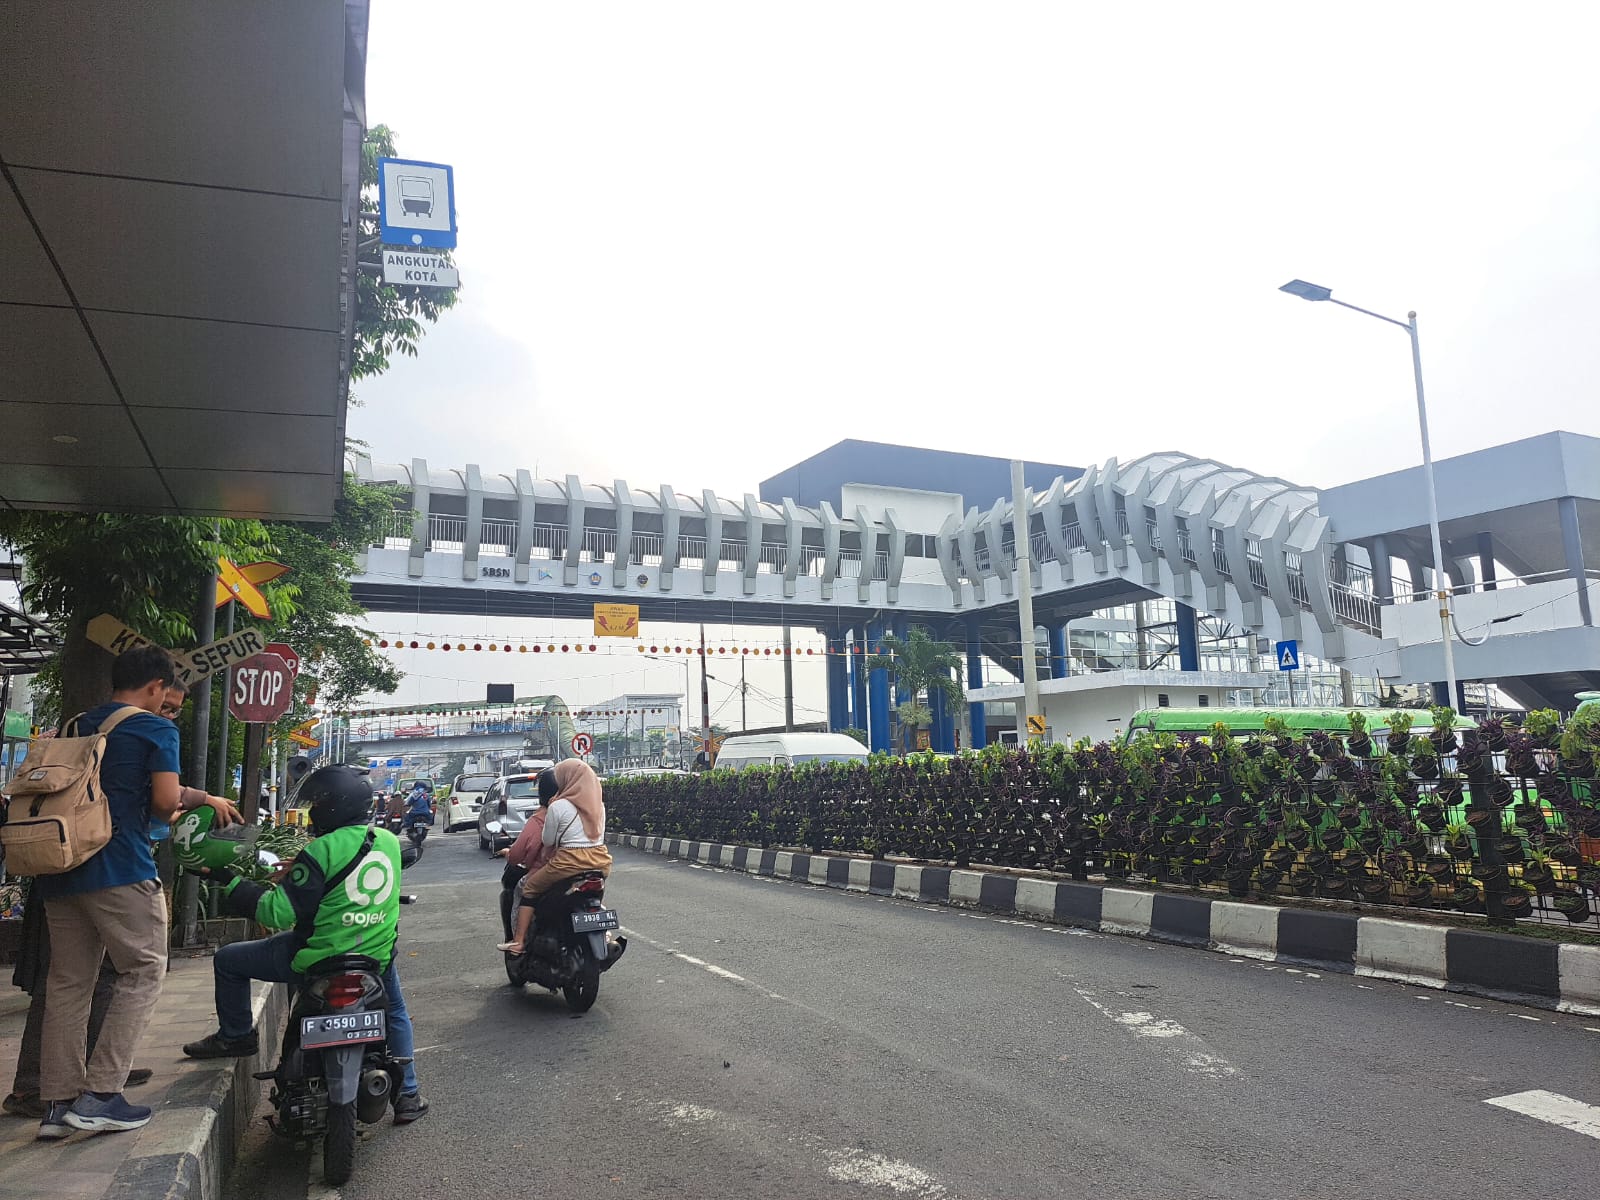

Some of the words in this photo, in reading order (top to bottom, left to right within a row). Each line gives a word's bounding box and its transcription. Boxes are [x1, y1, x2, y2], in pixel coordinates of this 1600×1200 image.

[405, 270, 438, 282] KOTA
[482, 566, 510, 578] SBSN
[191, 631, 263, 674] SEPUR
[234, 667, 283, 706] STOP
[341, 909, 386, 928] gojek
[306, 1021, 314, 1033] F
